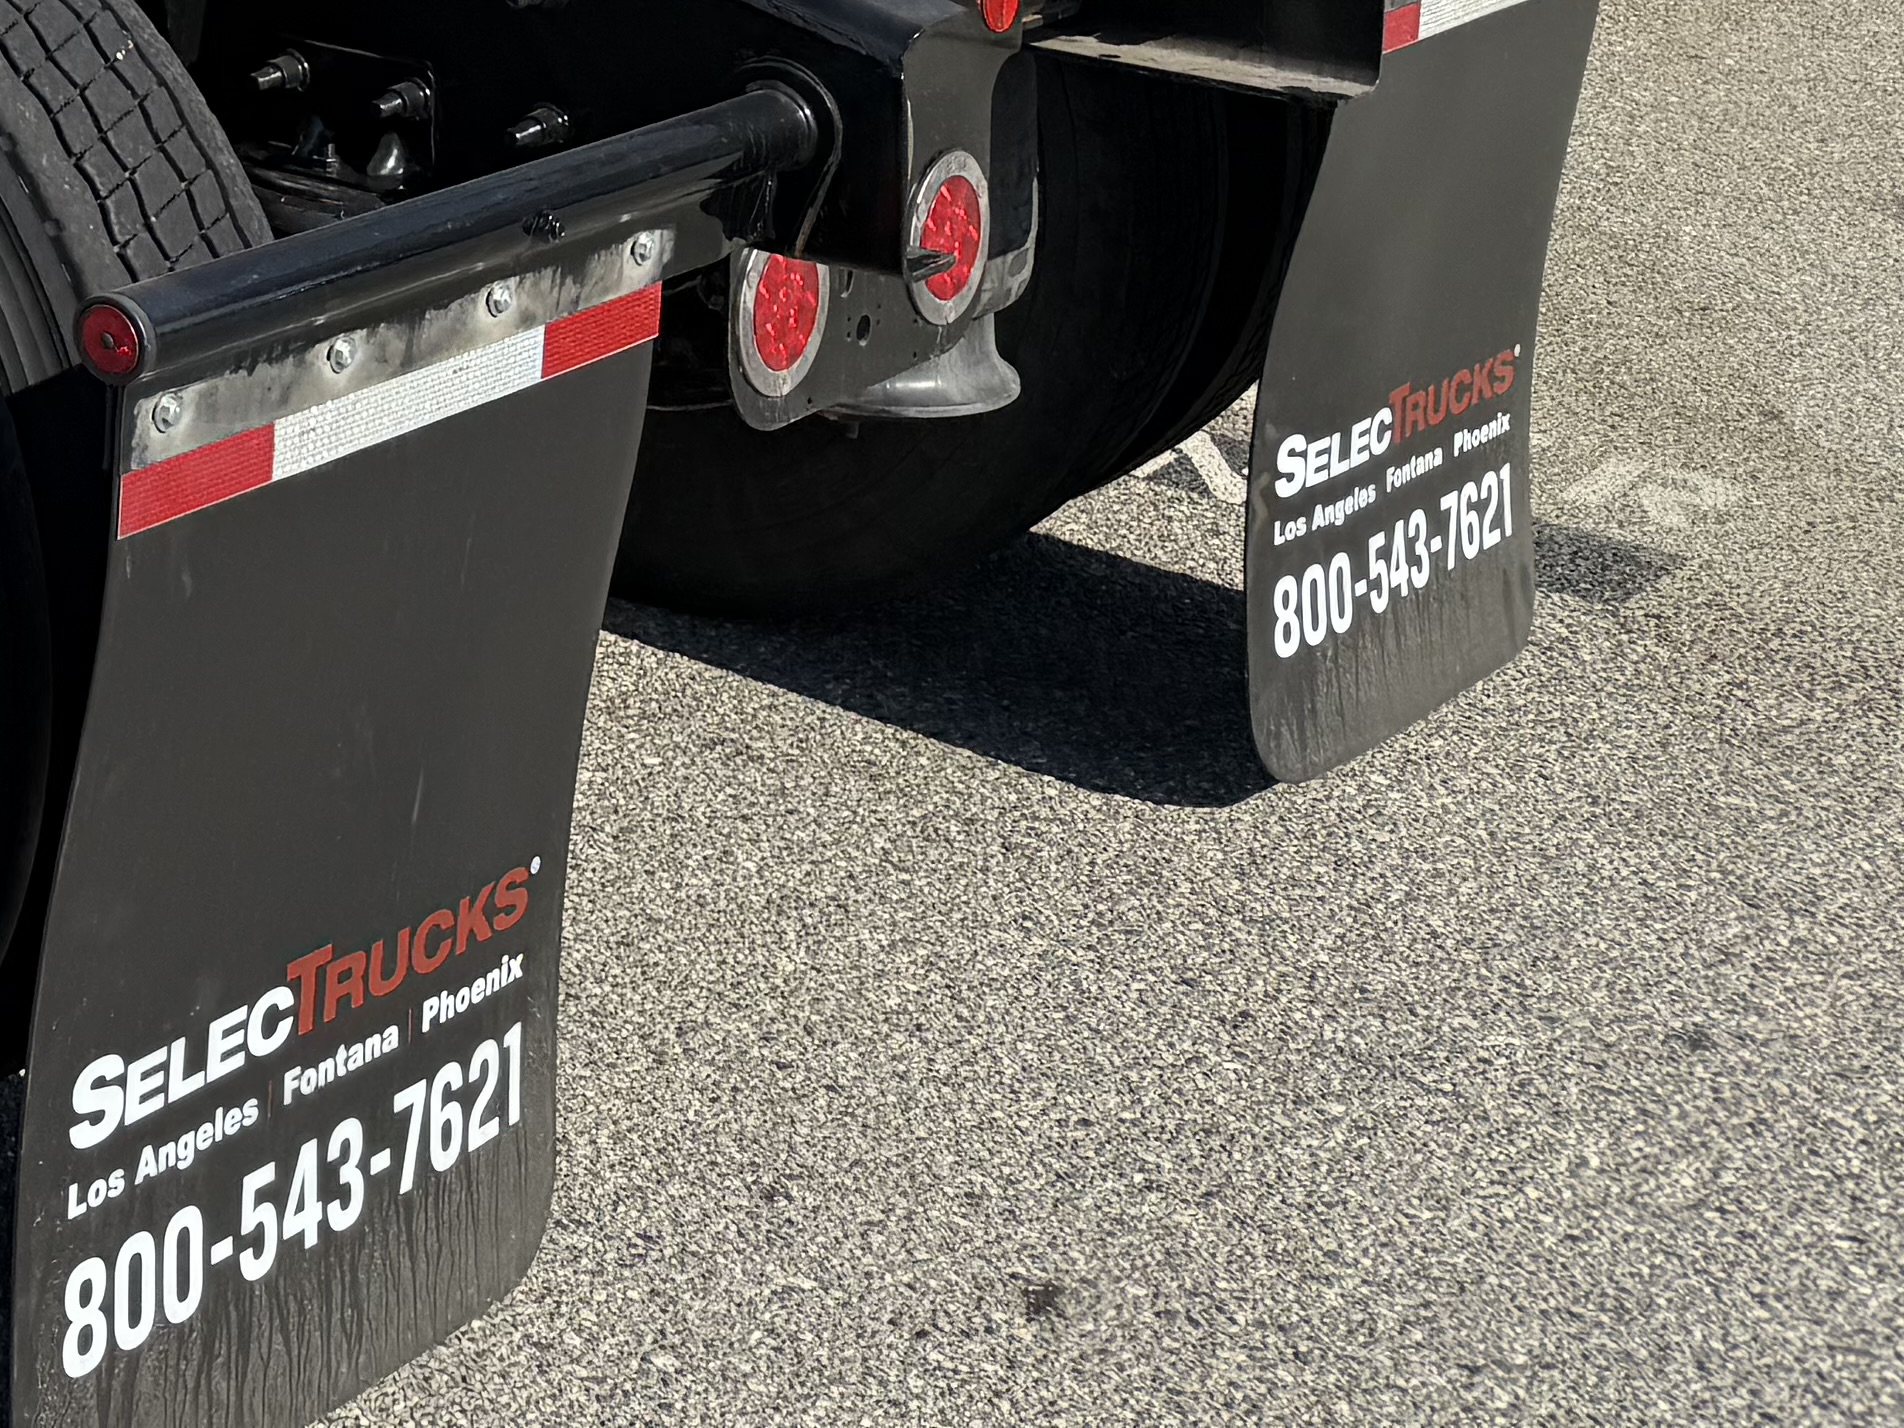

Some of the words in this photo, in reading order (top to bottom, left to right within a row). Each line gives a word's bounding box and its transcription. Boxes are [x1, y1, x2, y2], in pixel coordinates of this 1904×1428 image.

[1273, 514, 1307, 546] Los
[1311, 482, 1377, 532] Angeles
[1386, 447, 1444, 493] Fontana
[1453, 411, 1512, 457] Phoenix
[1274, 348, 1516, 498] SELECTRUCKS
[1273, 462, 1513, 659] 800-543-7621
[67, 1165, 126, 1220] Los
[134, 1094, 260, 1185] Angeles
[283, 1023, 400, 1107] Fontana
[420, 950, 525, 1033] Phoenix
[68, 866, 529, 1150] SELECTRUCKS
[61, 1020, 523, 1380] 800-543-7621
